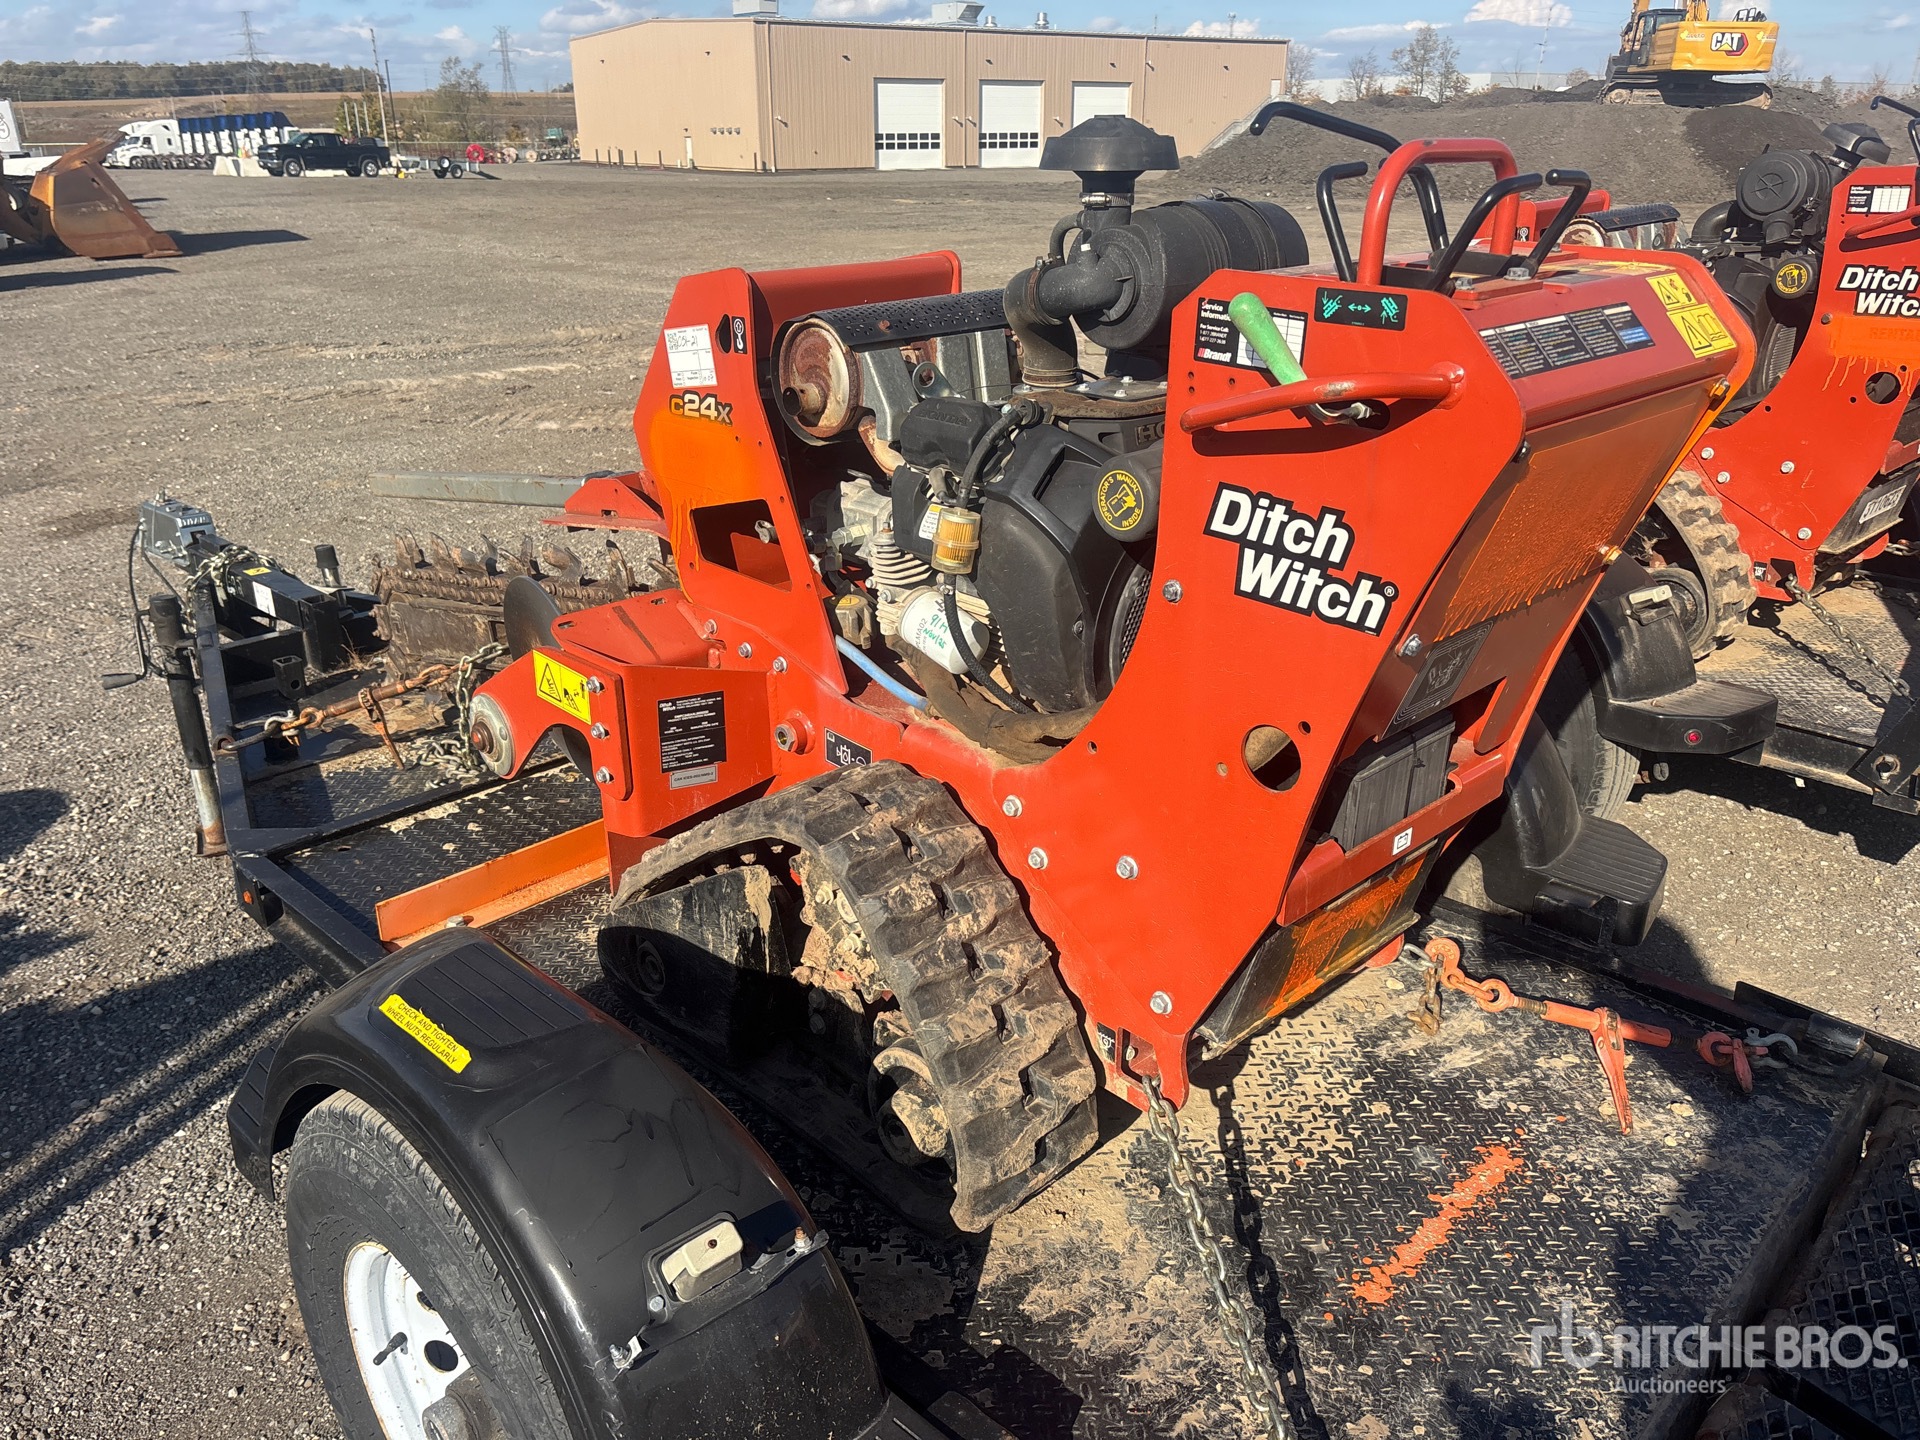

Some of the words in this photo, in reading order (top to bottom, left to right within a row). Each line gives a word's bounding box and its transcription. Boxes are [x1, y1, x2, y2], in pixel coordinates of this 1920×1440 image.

[1711, 32, 1741, 51] CAT
[1840, 267, 1919, 291] Ditch
[1201, 300, 1223, 312] Service
[1201, 310, 1231, 321] Informatio
[1856, 292, 1920, 316] Witc
[1203, 348, 1232, 362] Brandt
[1116, 474, 1139, 494] MANUAL
[1100, 477, 1114, 521] OPERATOR'S
[1121, 508, 1141, 527] INSIDE
[1210, 488, 1349, 563] Ditch
[1240, 548, 1386, 629] Witch
[386, 1006, 406, 1024] WHEEL
[404, 1021, 422, 1036] NUTS
[420, 1033, 458, 1065] REGULARLY
[398, 1003, 420, 1020] CHECK
[418, 1018, 432, 1031] AND
[430, 1028, 458, 1052] TIGHTEN
